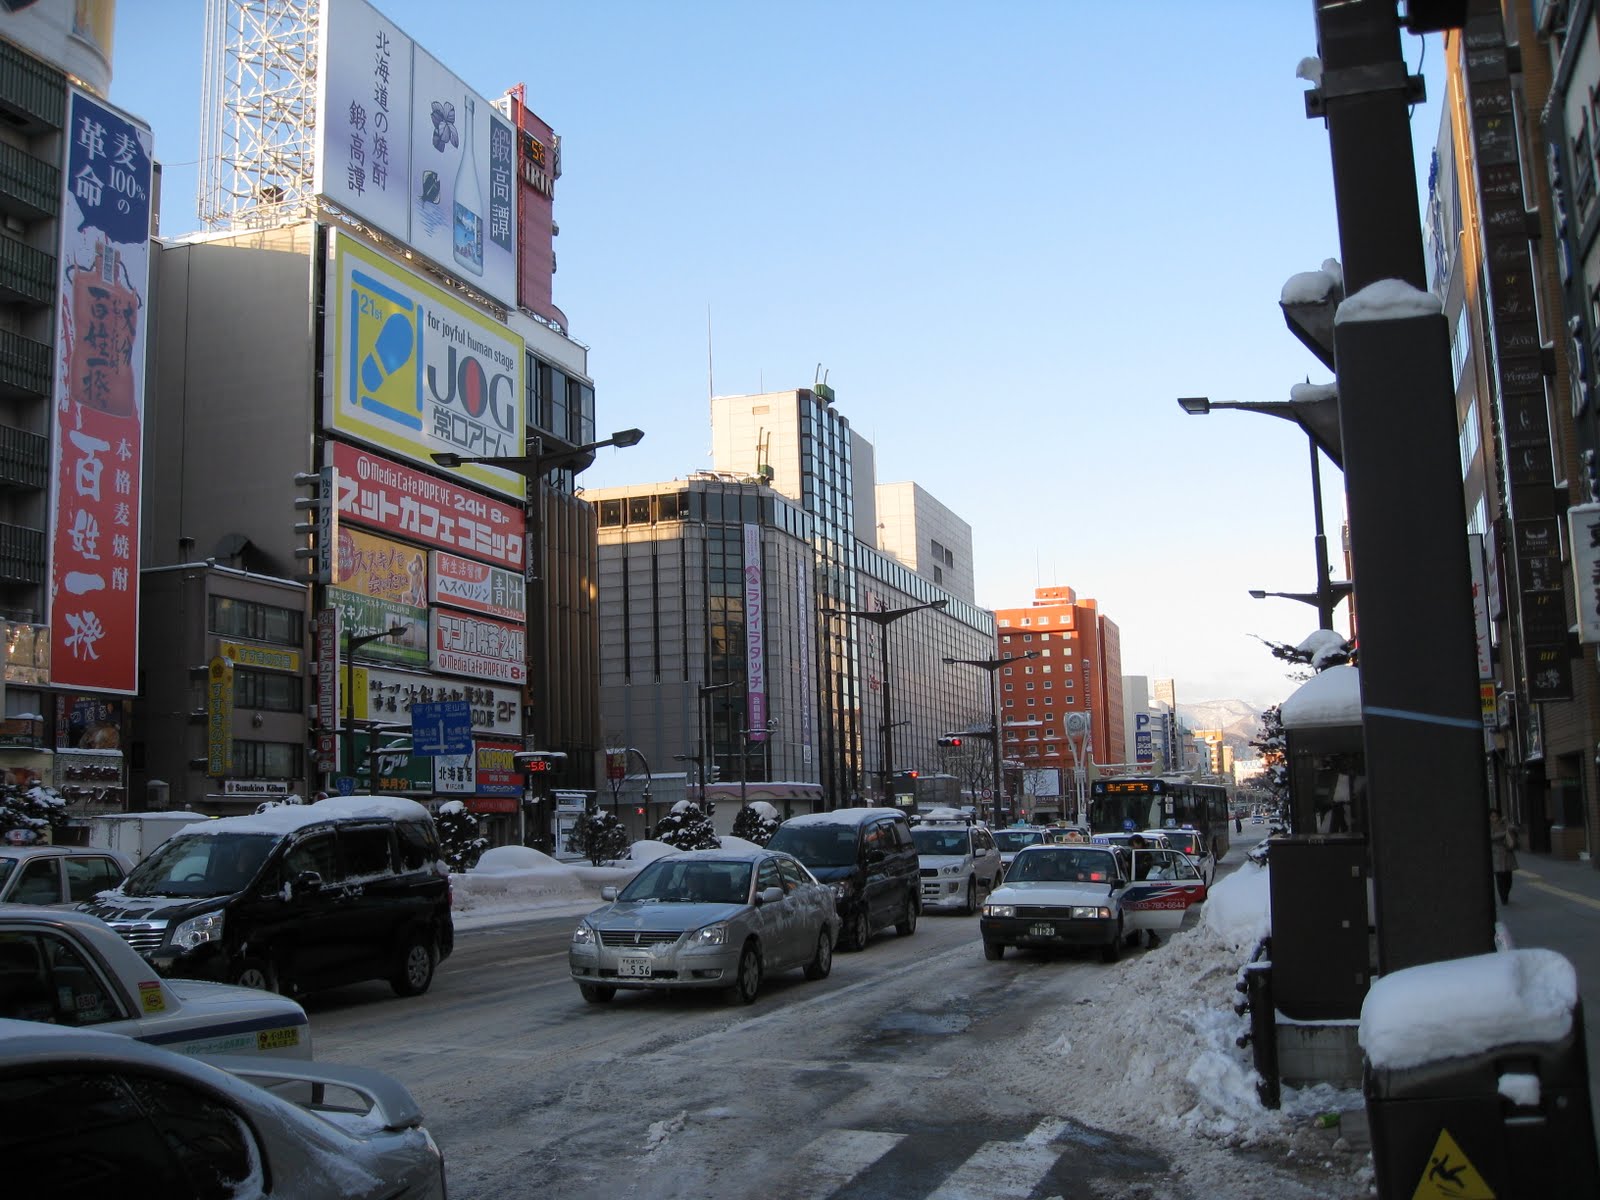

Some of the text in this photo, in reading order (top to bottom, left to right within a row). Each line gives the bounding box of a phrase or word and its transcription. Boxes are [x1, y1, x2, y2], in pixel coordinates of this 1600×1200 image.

[372, 30, 390, 192] 北海道の焼酎
[75, 116, 107, 207] 革命
[347, 99, 368, 198] 鍛高譚
[491, 126, 510, 242] 鍛高譚
[525, 162, 554, 201] IRIN
[360, 293, 383, 322] 21st
[427, 311, 514, 373] for joyful human stage
[427, 345, 514, 434] JOG
[433, 405, 508, 458] 常口アトム
[112, 438, 132, 593] 本格麦焼酎
[454, 494, 486, 519] 24H
[490, 508, 510, 525] 8F
[65, 429, 110, 661] 百姓一揆
[439, 578, 490, 602] ヘスペリジン
[492, 575, 522, 609] 青汁
[511, 666, 525, 680] 8F
[496, 700, 516, 722] 2F
[1136, 713, 1150, 730] P
[235, 784, 264, 792] Susukino
